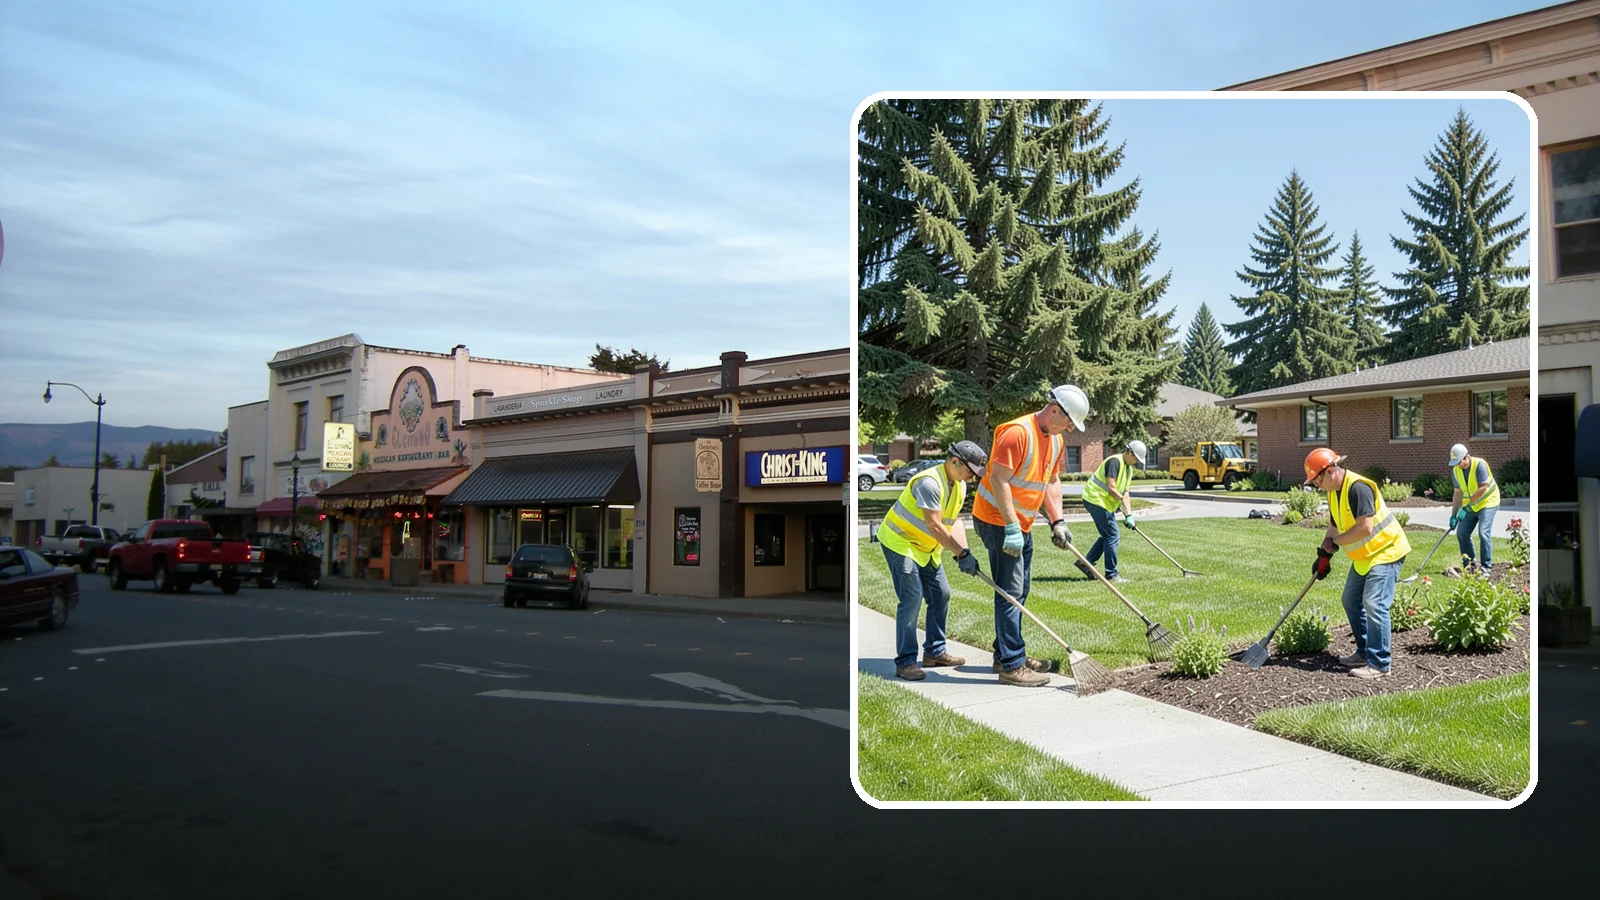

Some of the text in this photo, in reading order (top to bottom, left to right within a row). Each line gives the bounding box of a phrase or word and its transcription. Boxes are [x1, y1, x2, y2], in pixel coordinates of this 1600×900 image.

[530, 394, 582, 409] Sparkle Shop
[596, 389, 623, 400] LAUNDRY
[493, 402, 522, 413] LAVANDERIA
[374, 450, 450, 464] MEXICAN RESTAURANT BAR
[799, 450, 827, 477] KING
